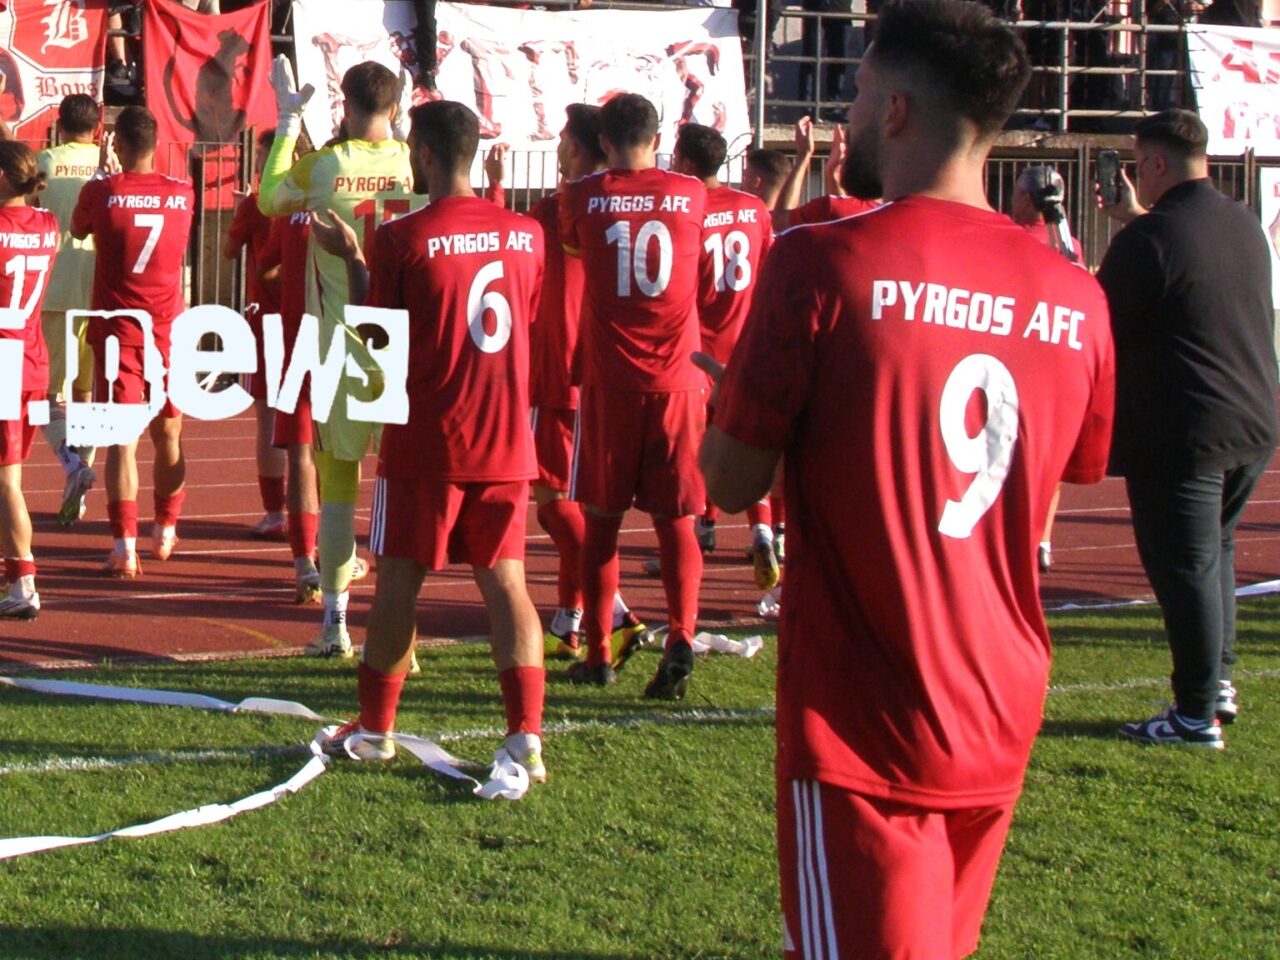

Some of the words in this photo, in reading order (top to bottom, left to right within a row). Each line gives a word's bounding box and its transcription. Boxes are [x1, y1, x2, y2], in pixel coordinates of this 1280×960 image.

[108, 195, 161, 209] PYRGOS
[334, 176, 397, 193] PYRGOS
[588, 196, 655, 214] PYRGOS
[660, 196, 691, 213] AFC
[133, 214, 164, 274] 7
[428, 232, 499, 258] PYRGOS
[505, 231, 533, 253] AFC
[703, 211, 734, 228] RGOS
[737, 209, 757, 224] AFC
[5, 254, 51, 320] 17
[605, 220, 673, 298] 10
[704, 231, 752, 292] 18
[467, 261, 512, 354] 6
[872, 280, 1015, 336] PYRGOS
[1023, 302, 1085, 351] AFC
[937, 353, 1019, 539] 9
